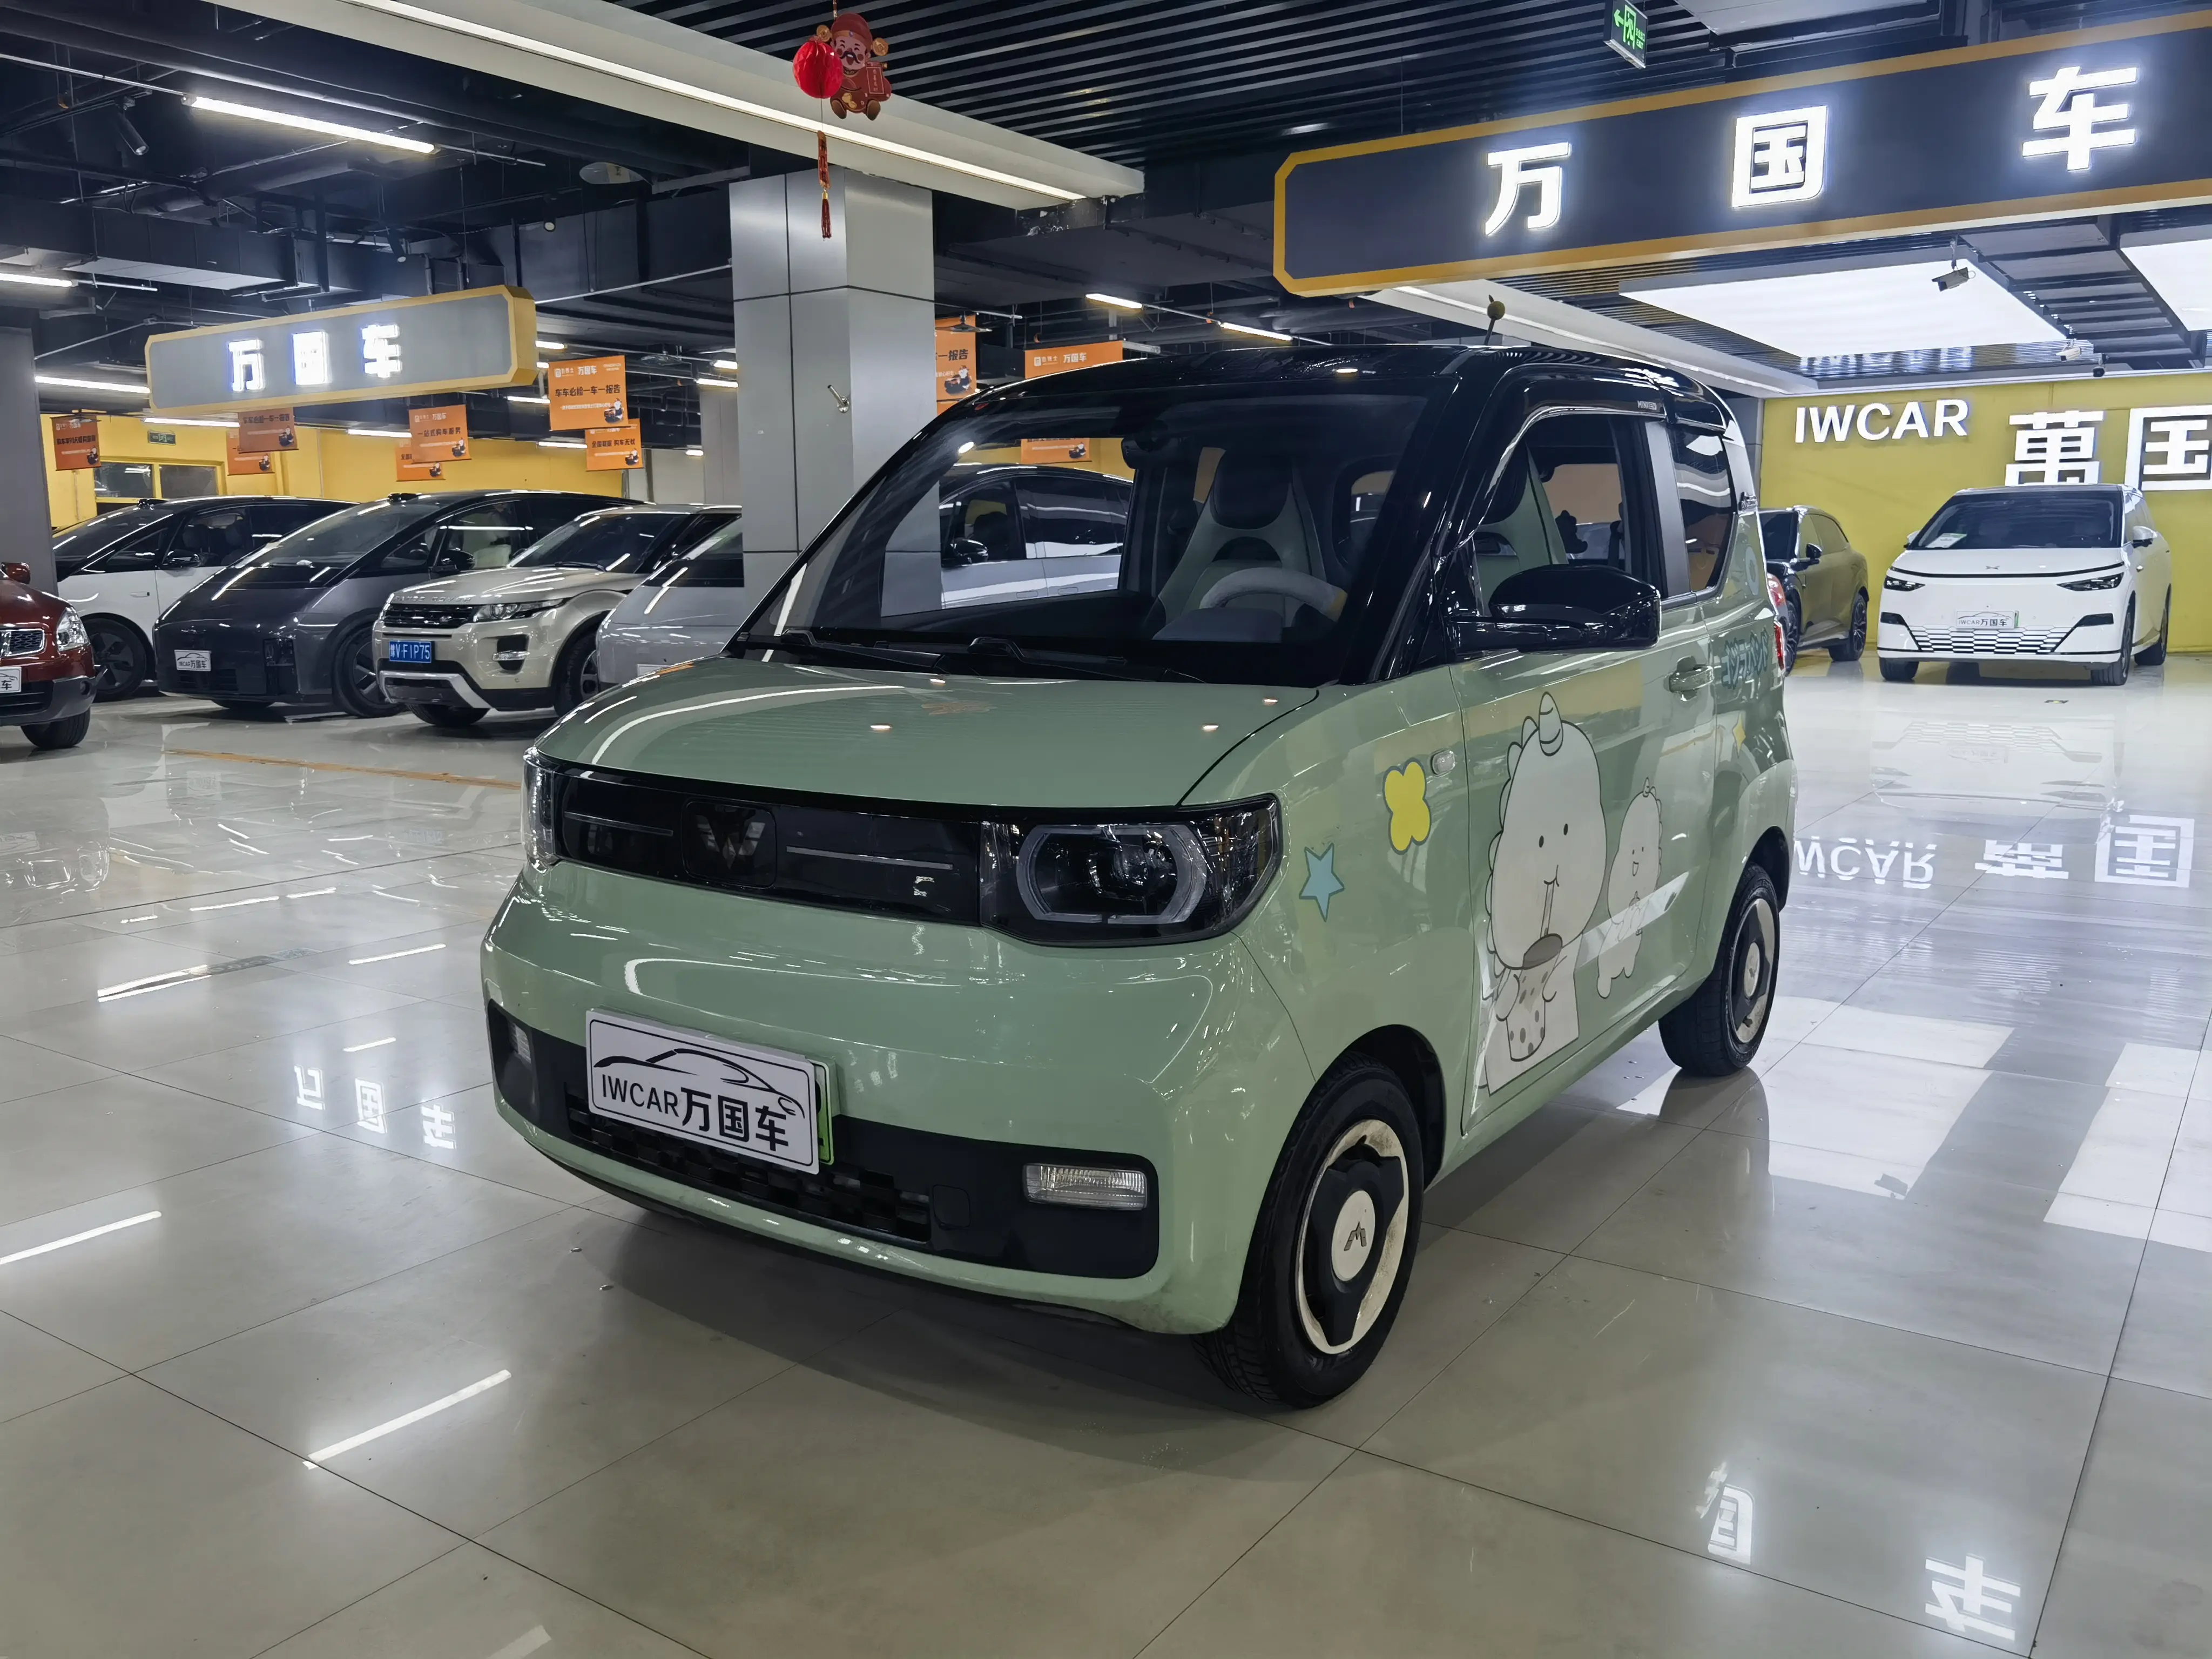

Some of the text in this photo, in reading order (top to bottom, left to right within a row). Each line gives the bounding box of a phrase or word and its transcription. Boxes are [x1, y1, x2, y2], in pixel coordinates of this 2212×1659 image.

[1484, 65, 2139, 237] 万国车
[228, 323, 402, 392] 万国车
[935, 349, 968, 361] 一报告
[555, 384, 621, 397] 车车必检一车一报告
[1795, 399, 1970, 443] IWCAR
[602, 1074, 789, 1152] IWCAR万国车
